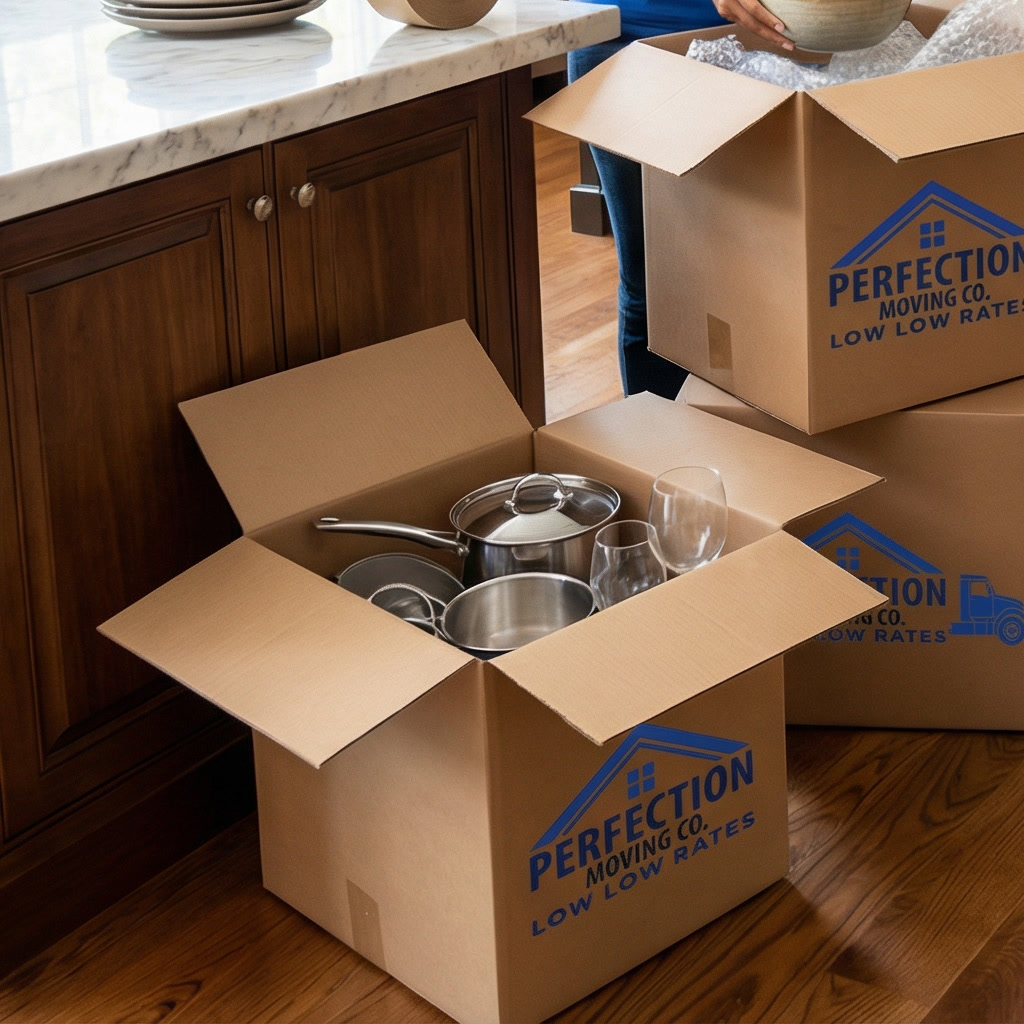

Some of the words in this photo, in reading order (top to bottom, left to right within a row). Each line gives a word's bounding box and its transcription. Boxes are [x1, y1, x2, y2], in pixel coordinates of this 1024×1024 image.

[879, 288, 956, 320] MOVING
[962, 283, 990, 303] CO.
[831, 325, 885, 349] LOW
[896, 312, 950, 336] LOW
[878, 609, 906, 625] CO.
[874, 629, 947, 643] RATES
[529, 749, 754, 893] PERFECTION
[586, 829, 671, 888] MOVING
[677, 814, 709, 841] CO.
[532, 892, 593, 936] LOW
[604, 856, 664, 900] LOW
[674, 811, 756, 864] RATES
